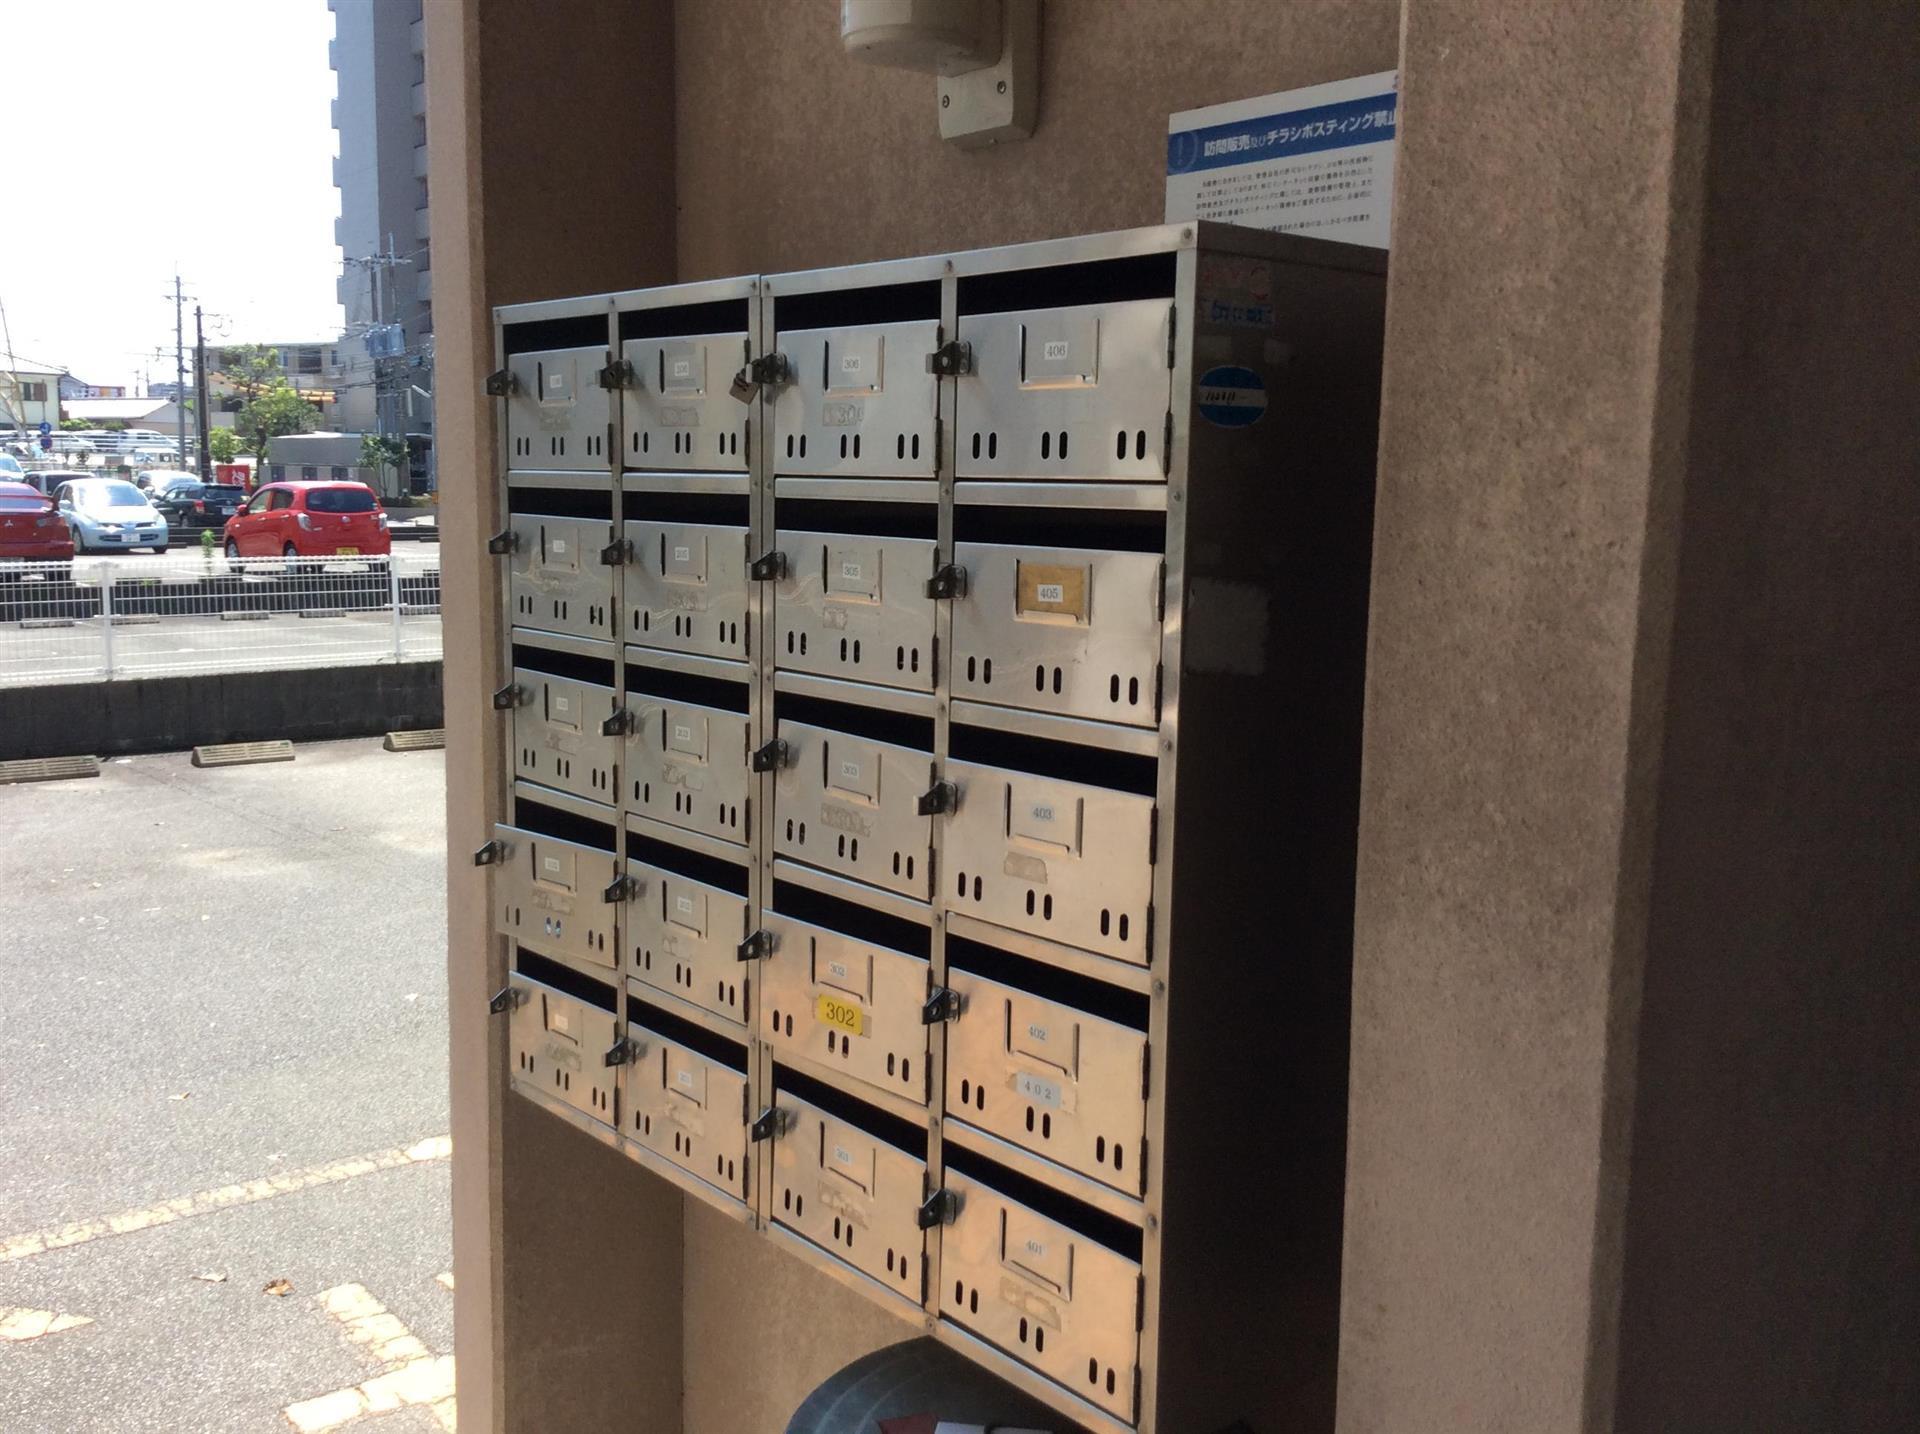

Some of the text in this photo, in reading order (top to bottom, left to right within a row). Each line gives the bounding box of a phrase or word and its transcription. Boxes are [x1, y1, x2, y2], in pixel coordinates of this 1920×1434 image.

[1047, 345, 1066, 358] 406
[1039, 587, 1059, 600] 405
[1032, 806, 1052, 820] 403
[826, 1002, 855, 1027] 302
